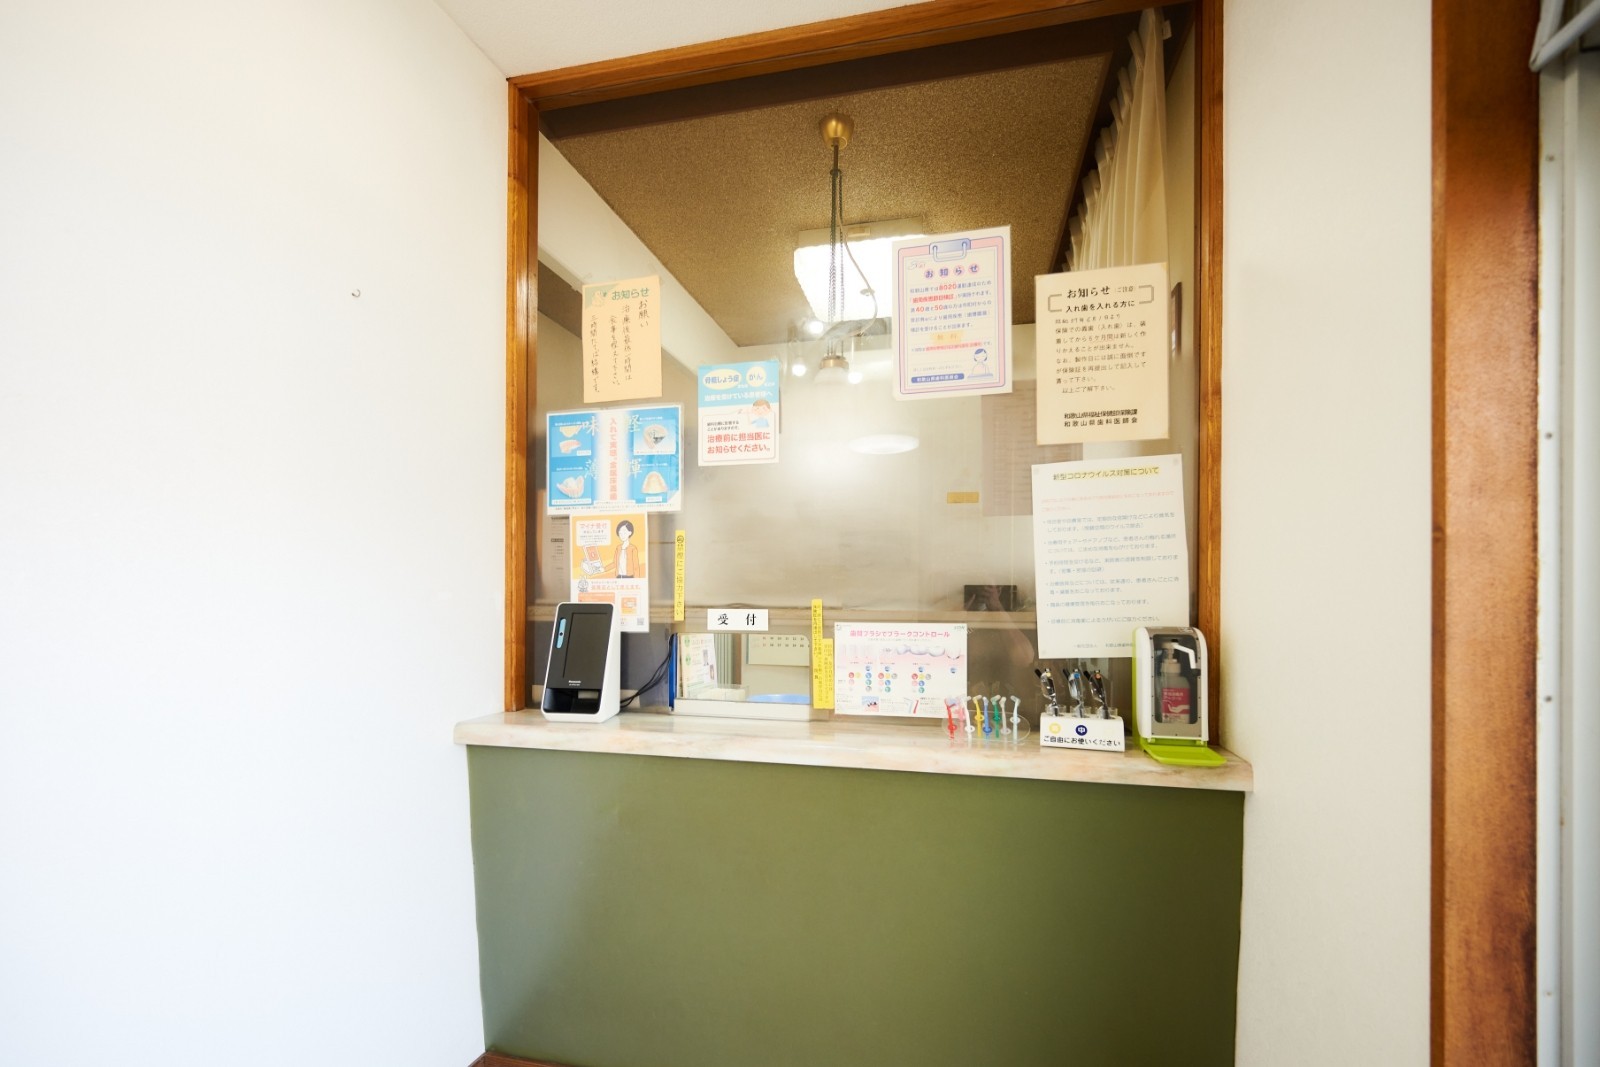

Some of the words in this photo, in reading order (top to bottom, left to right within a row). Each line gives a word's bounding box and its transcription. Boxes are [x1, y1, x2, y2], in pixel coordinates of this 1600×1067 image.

[925, 264, 979, 279] お知らせ
[611, 287, 650, 301] お知らせ
[1067, 286, 1110, 299] お知らせ
[1066, 300, 1135, 313] 入れ歯を入れる方に
[1064, 417, 1138, 428] 和歌山県歯科医師会
[707, 431, 771, 444] 治療前に担当医に
[707, 443, 771, 454] お知らせください。
[1053, 466, 1159, 481] 新型コロナウイルス対策について
[717, 613, 757, 626] 受付
[850, 630, 950, 638] 歯間ブラシでプラークコントロール
[1043, 735, 1121, 747] ご自由にお使いください
